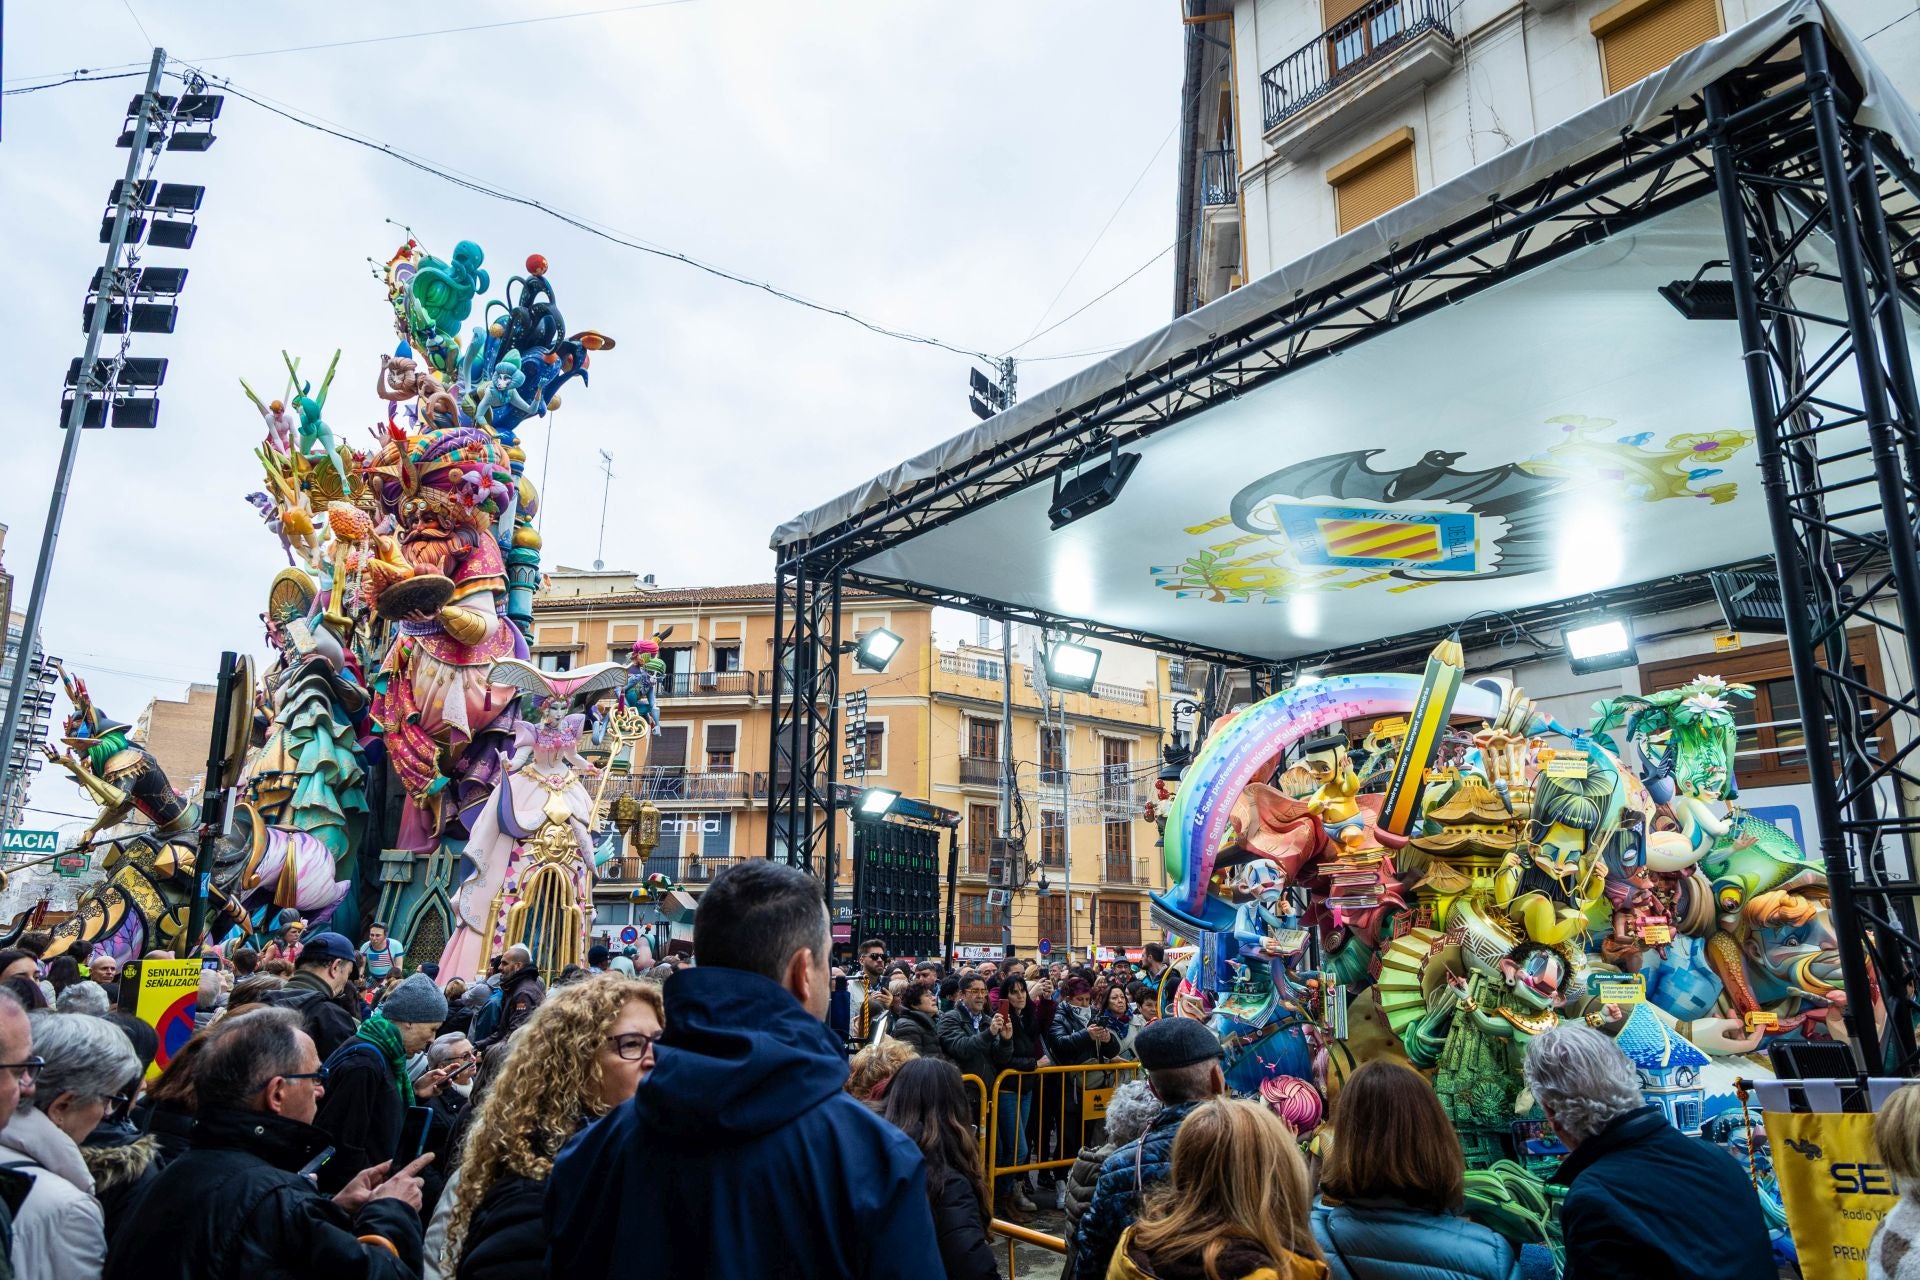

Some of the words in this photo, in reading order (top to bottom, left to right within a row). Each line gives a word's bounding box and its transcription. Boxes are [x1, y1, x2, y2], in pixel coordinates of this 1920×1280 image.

[1323, 510, 1444, 523] COMISION
[1252, 743, 1273, 765] núvol
[1212, 751, 1241, 796] professor
[1244, 764, 1253, 775] el
[1235, 774, 1245, 786] en
[1218, 788, 1236, 814] Martí
[1209, 817, 1223, 840] Sant
[1206, 844, 1215, 856] de
[147, 967, 202, 977] SENYALITZA
[1842, 1209, 1872, 1221] Radio
[1833, 1245, 1870, 1261] PREM
